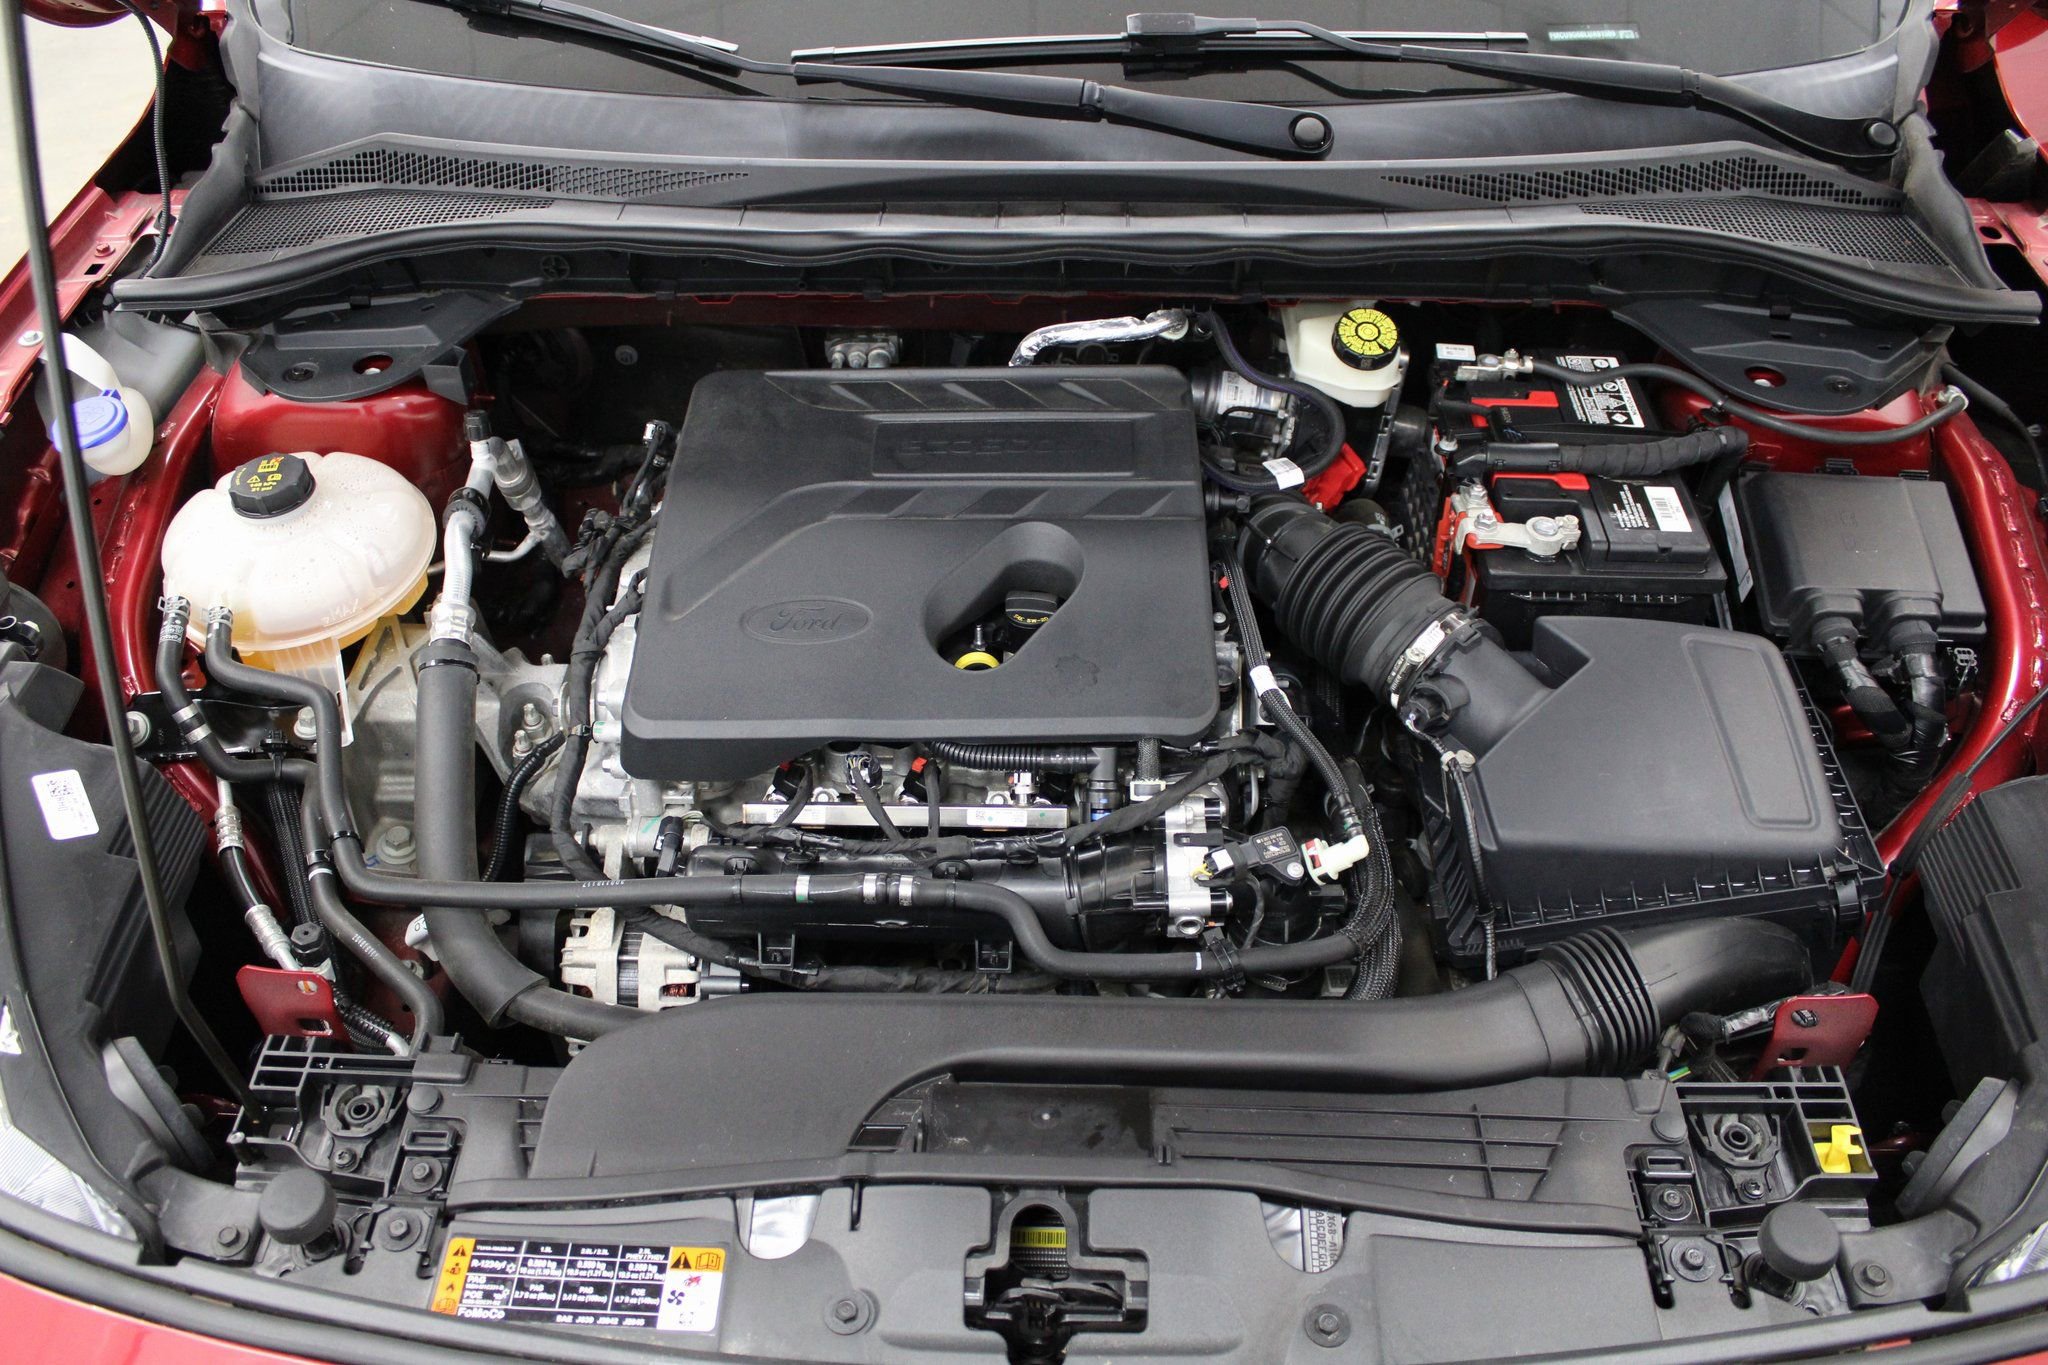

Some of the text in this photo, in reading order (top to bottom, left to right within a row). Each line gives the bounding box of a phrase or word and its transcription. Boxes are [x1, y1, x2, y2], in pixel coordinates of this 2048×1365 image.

[769, 606, 842, 633] Ford
[471, 1259, 507, 1270] R-1234yf
[547, 1260, 557, 1270] kg
[597, 1262, 606, 1271] kg
[648, 1264, 658, 1274] kg
[467, 1275, 486, 1283] PAG
[529, 1283, 544, 1291] PAG
[579, 1286, 594, 1294] PAG
[457, 1308, 505, 1319] FoMoCo
